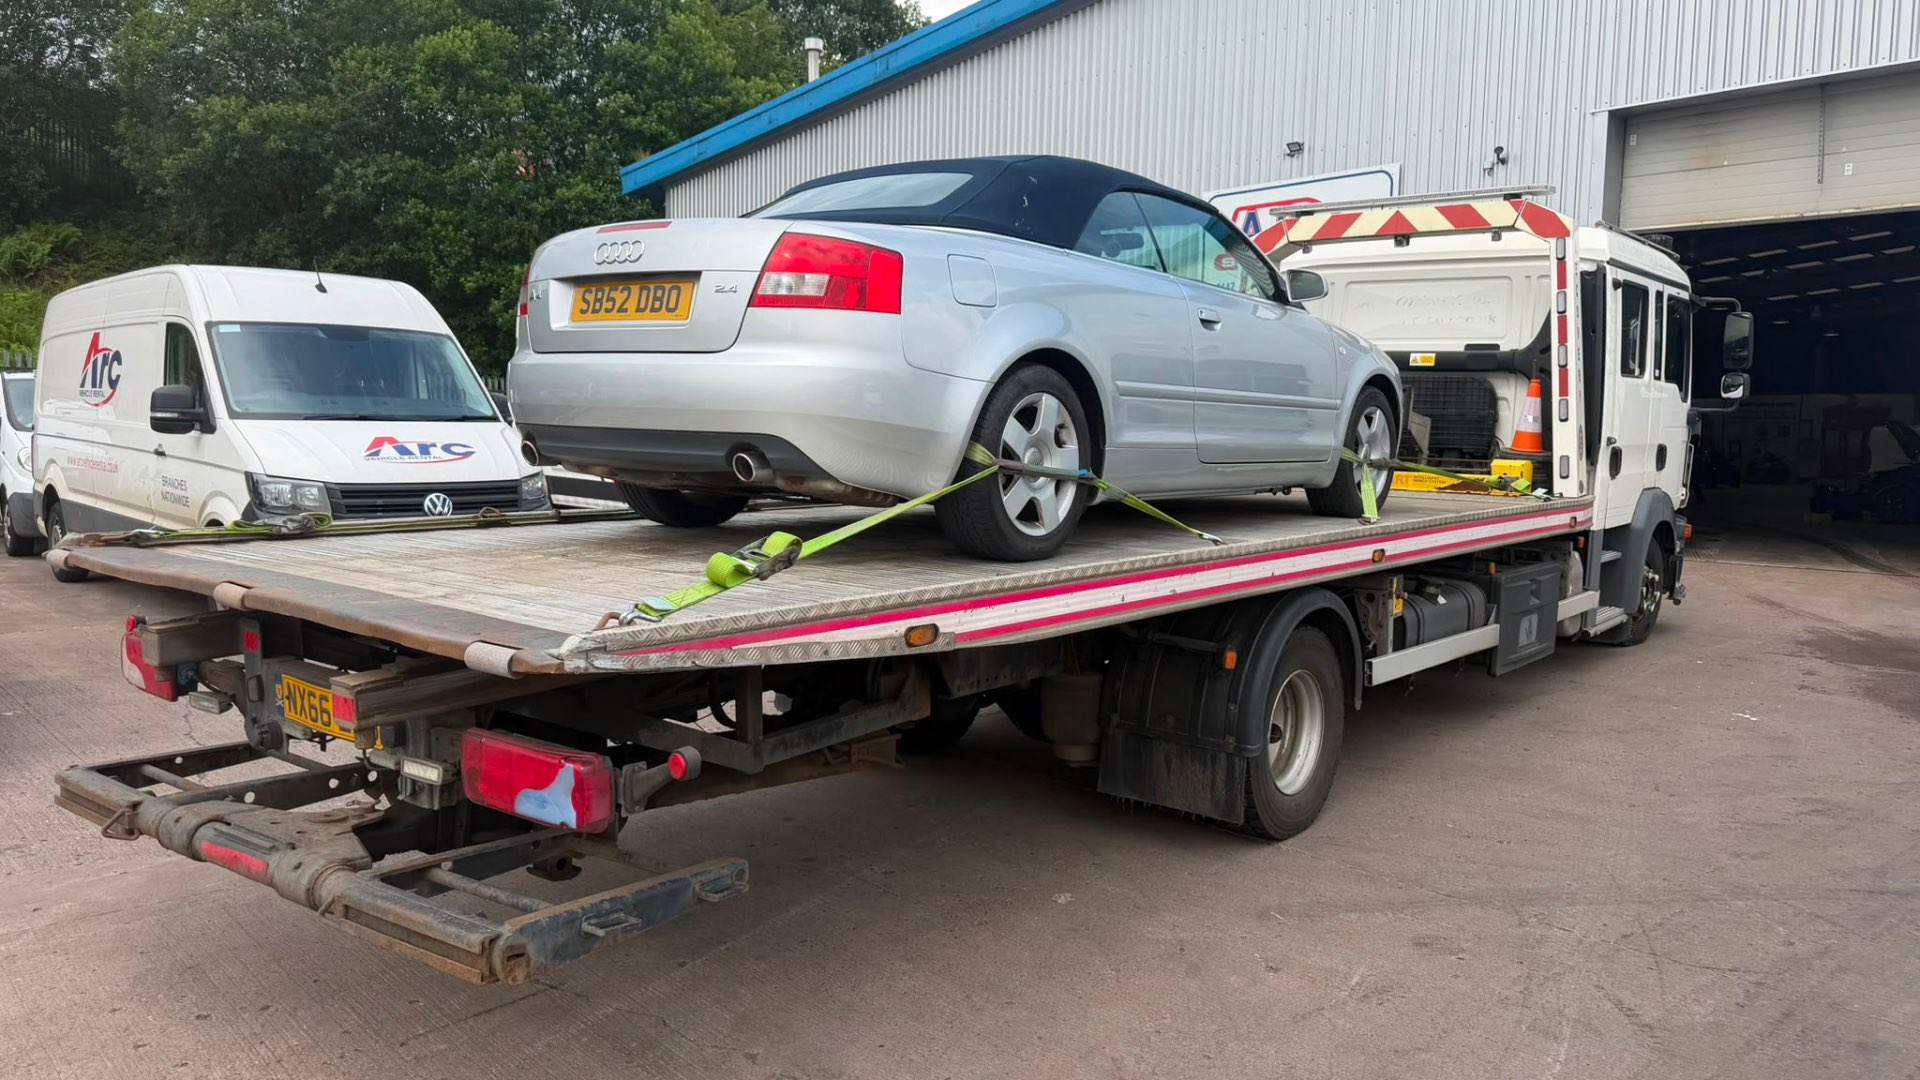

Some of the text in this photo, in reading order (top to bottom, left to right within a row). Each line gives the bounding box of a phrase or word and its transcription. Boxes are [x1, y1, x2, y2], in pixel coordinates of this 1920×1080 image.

[579, 285, 682, 315] SB52 DBO
[80, 332, 123, 390] Arc
[364, 436, 477, 457] Arc
[161, 474, 188, 492] BRANCHES
[160, 490, 190, 508] NATIONWIDE
[285, 681, 331, 728] NX66
